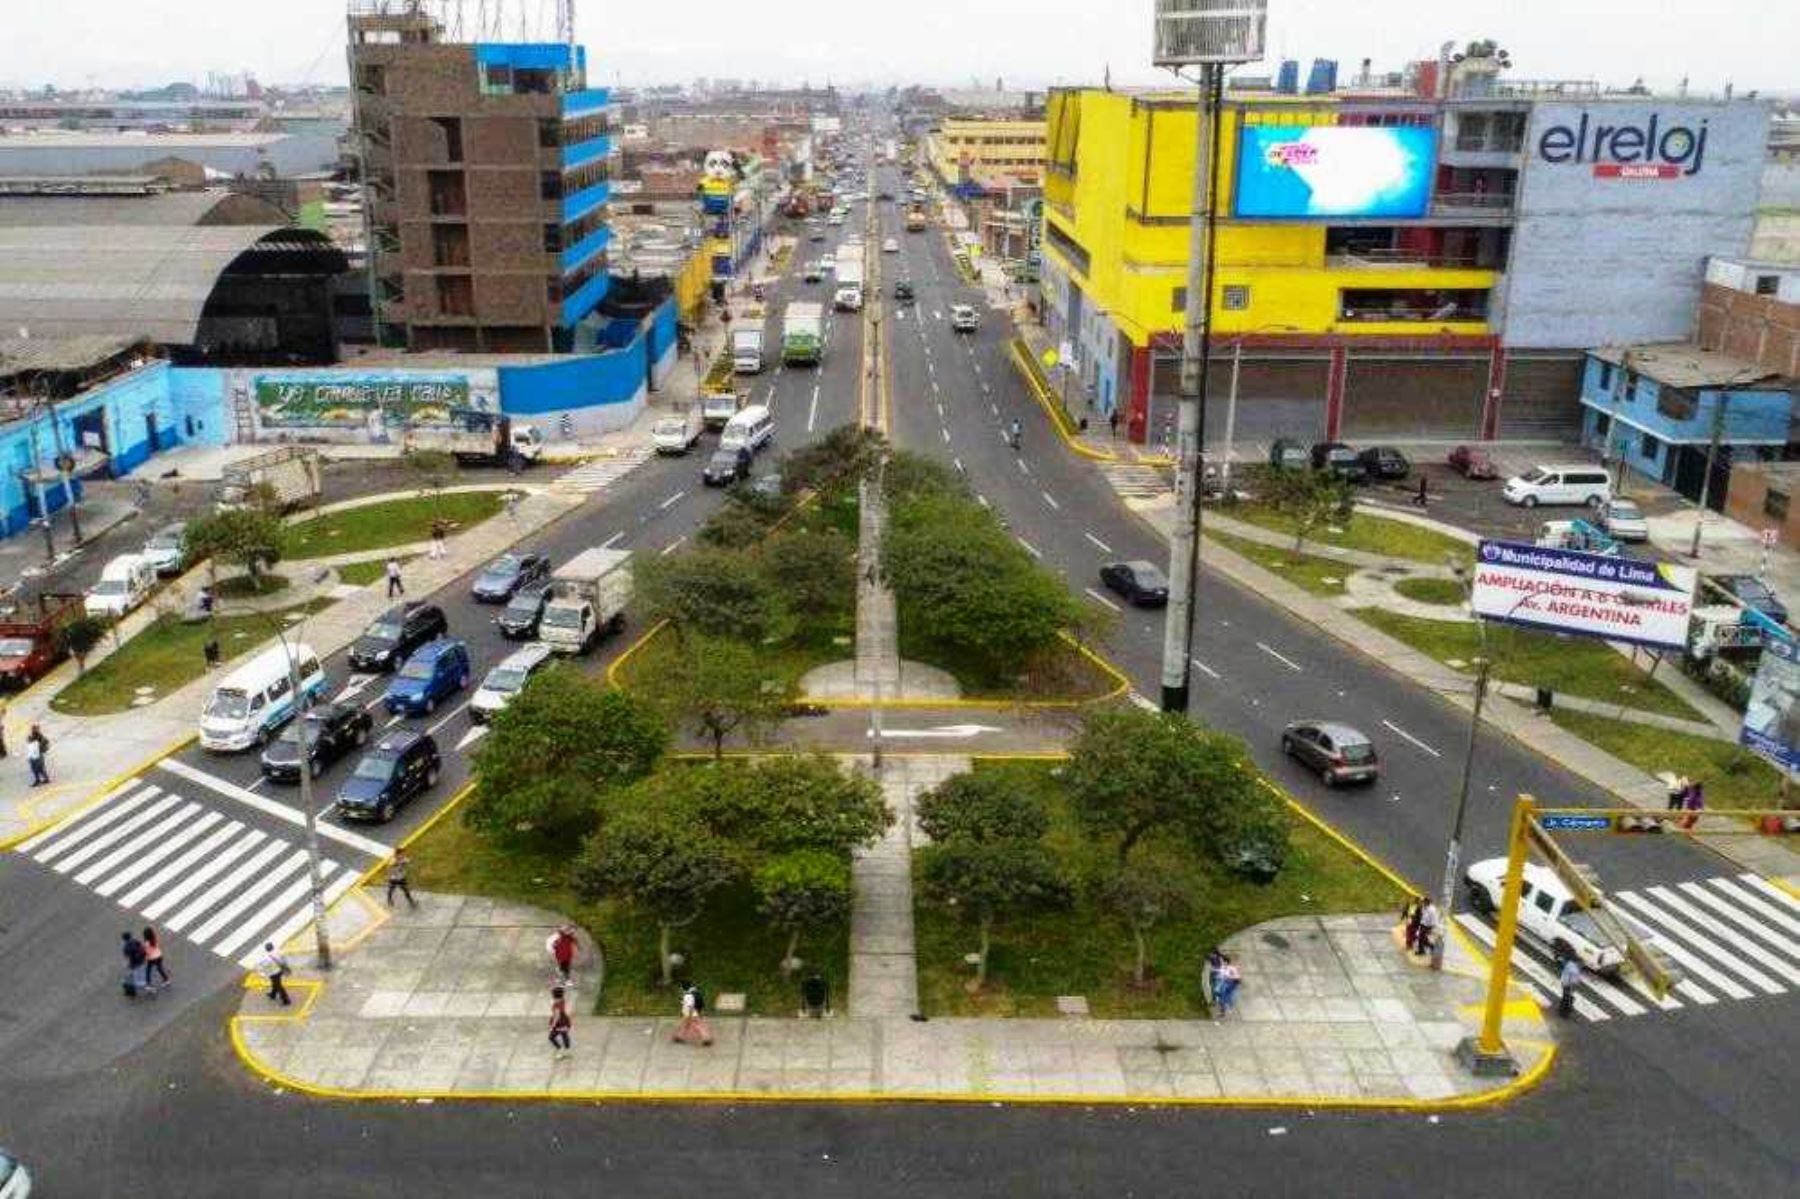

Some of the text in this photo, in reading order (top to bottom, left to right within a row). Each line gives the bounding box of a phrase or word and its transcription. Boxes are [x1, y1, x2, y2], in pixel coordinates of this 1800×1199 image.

[1540, 113, 1708, 175] el reloj
[1502, 548, 1655, 582] Municipalidad de Lima
[1478, 573, 1576, 598] AMPLIACIÓN
[1547, 602, 1641, 625] ARGENTINA
